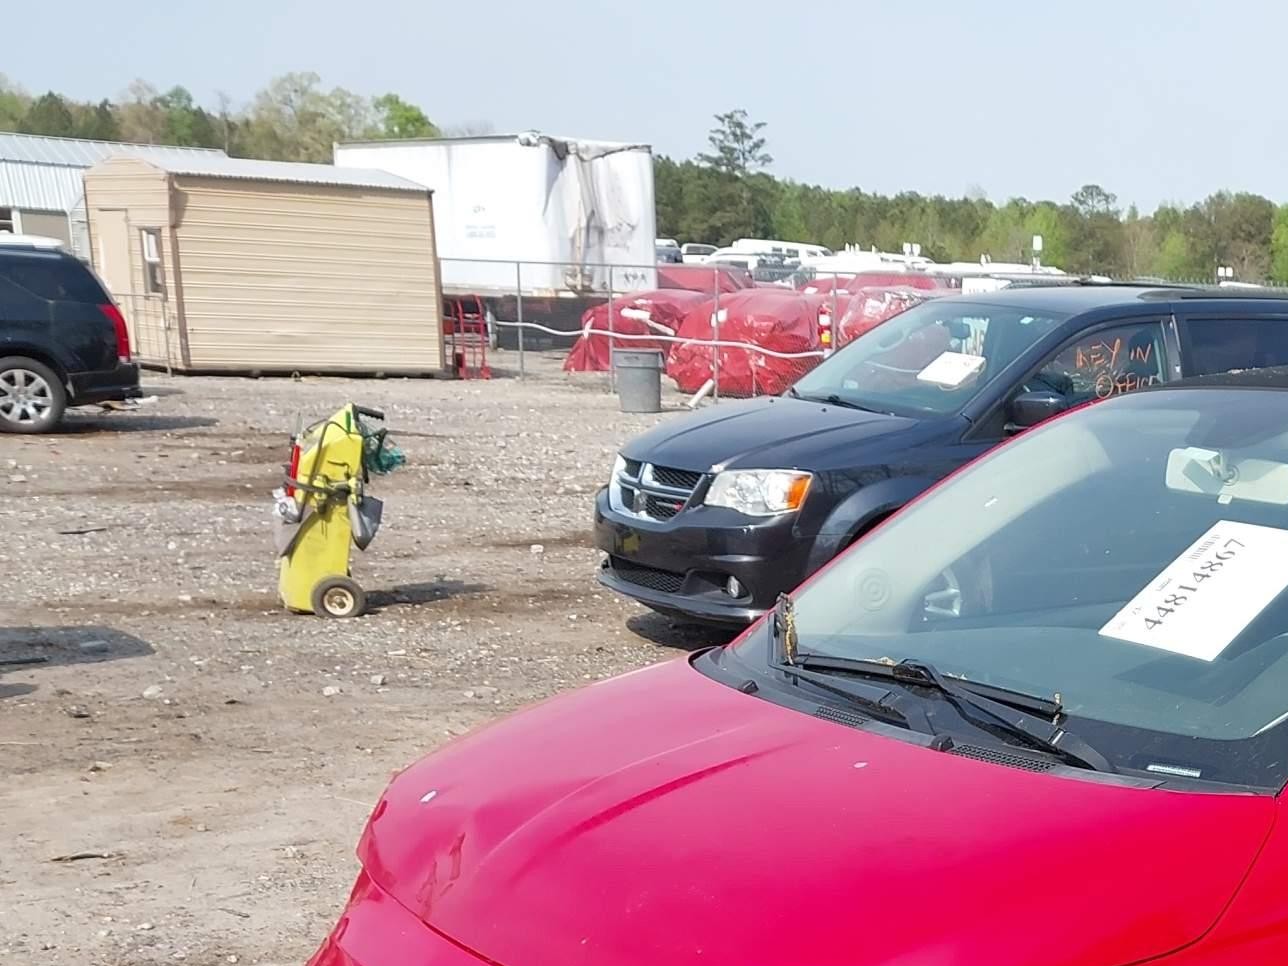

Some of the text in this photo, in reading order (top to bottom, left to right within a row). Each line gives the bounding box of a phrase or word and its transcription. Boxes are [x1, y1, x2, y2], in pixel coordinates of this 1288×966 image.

[1075, 338, 1151, 370] KEY IN
[1144, 538, 1246, 630] 44814867
